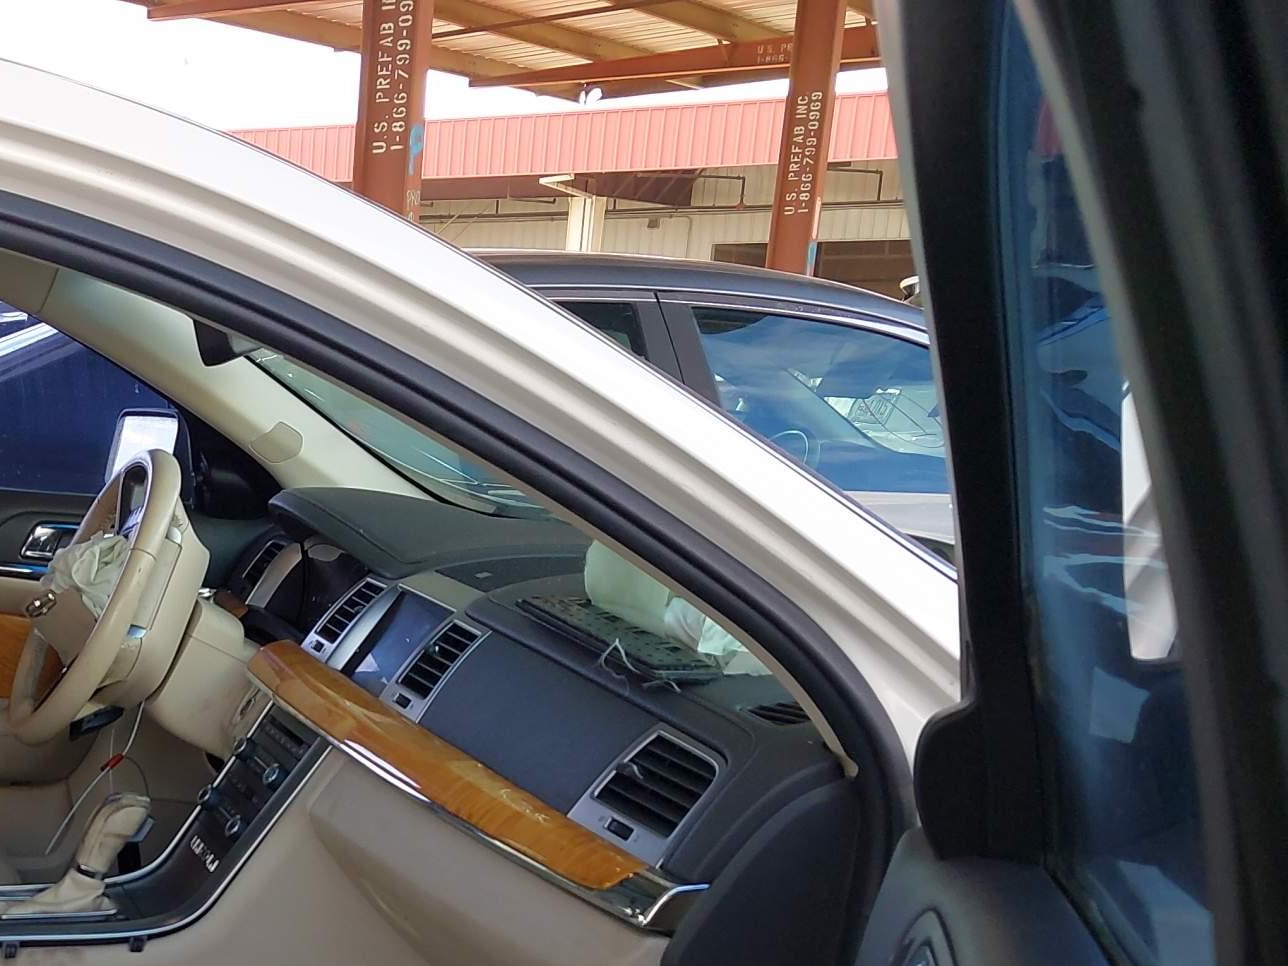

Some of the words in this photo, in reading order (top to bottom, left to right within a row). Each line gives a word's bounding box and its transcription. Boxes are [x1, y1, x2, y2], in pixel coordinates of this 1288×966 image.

[376, 22, 394, 103] PREFAB
[372, 115, 390, 154] U.S.
[788, 126, 805, 180] PREFAB
[798, 91, 823, 213] 1-866-799-0969
